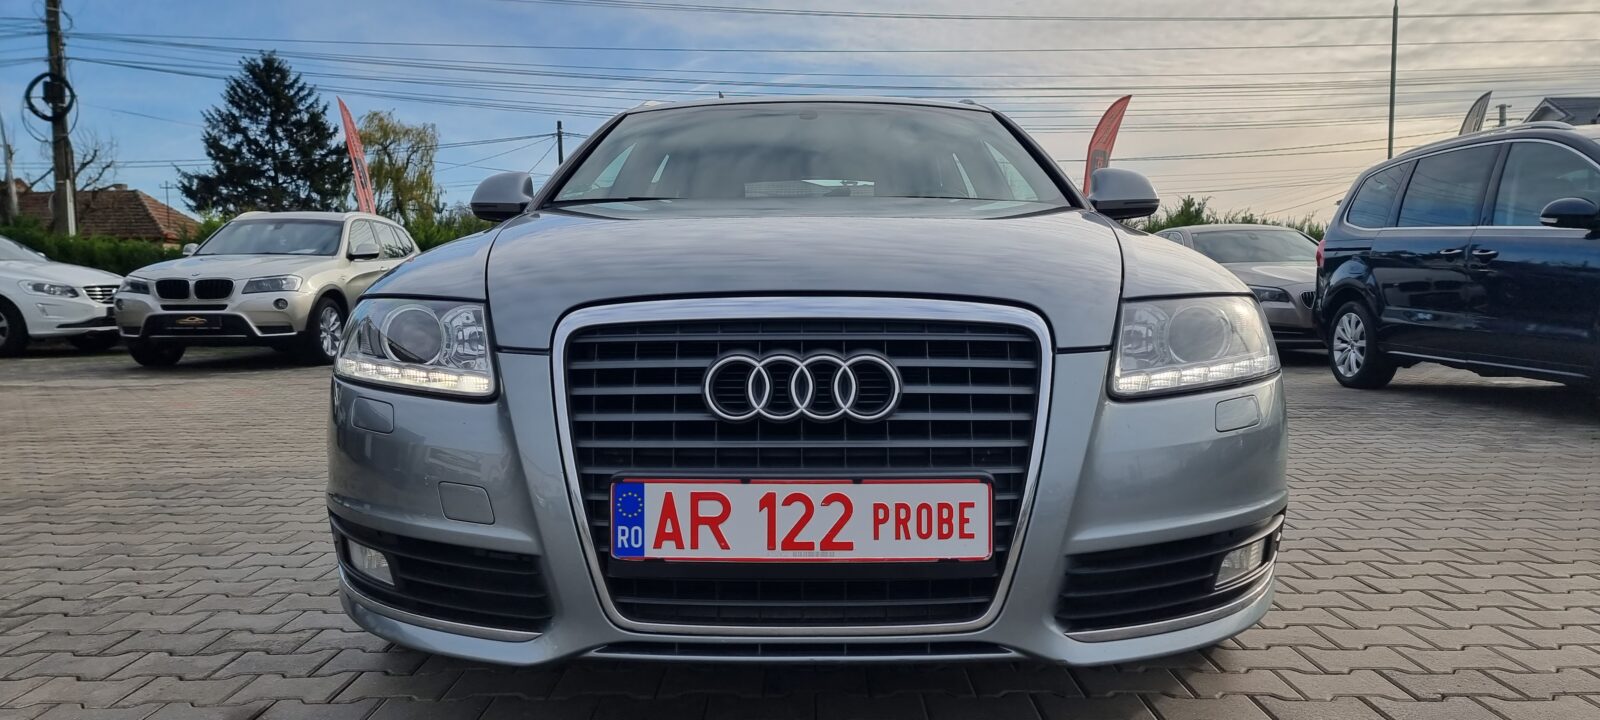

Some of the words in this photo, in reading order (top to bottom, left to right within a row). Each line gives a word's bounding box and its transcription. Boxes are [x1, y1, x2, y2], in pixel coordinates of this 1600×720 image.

[617, 525, 642, 548] RO
[653, 491, 732, 550] AR
[759, 491, 854, 551] 122
[873, 501, 975, 540] PROBE
